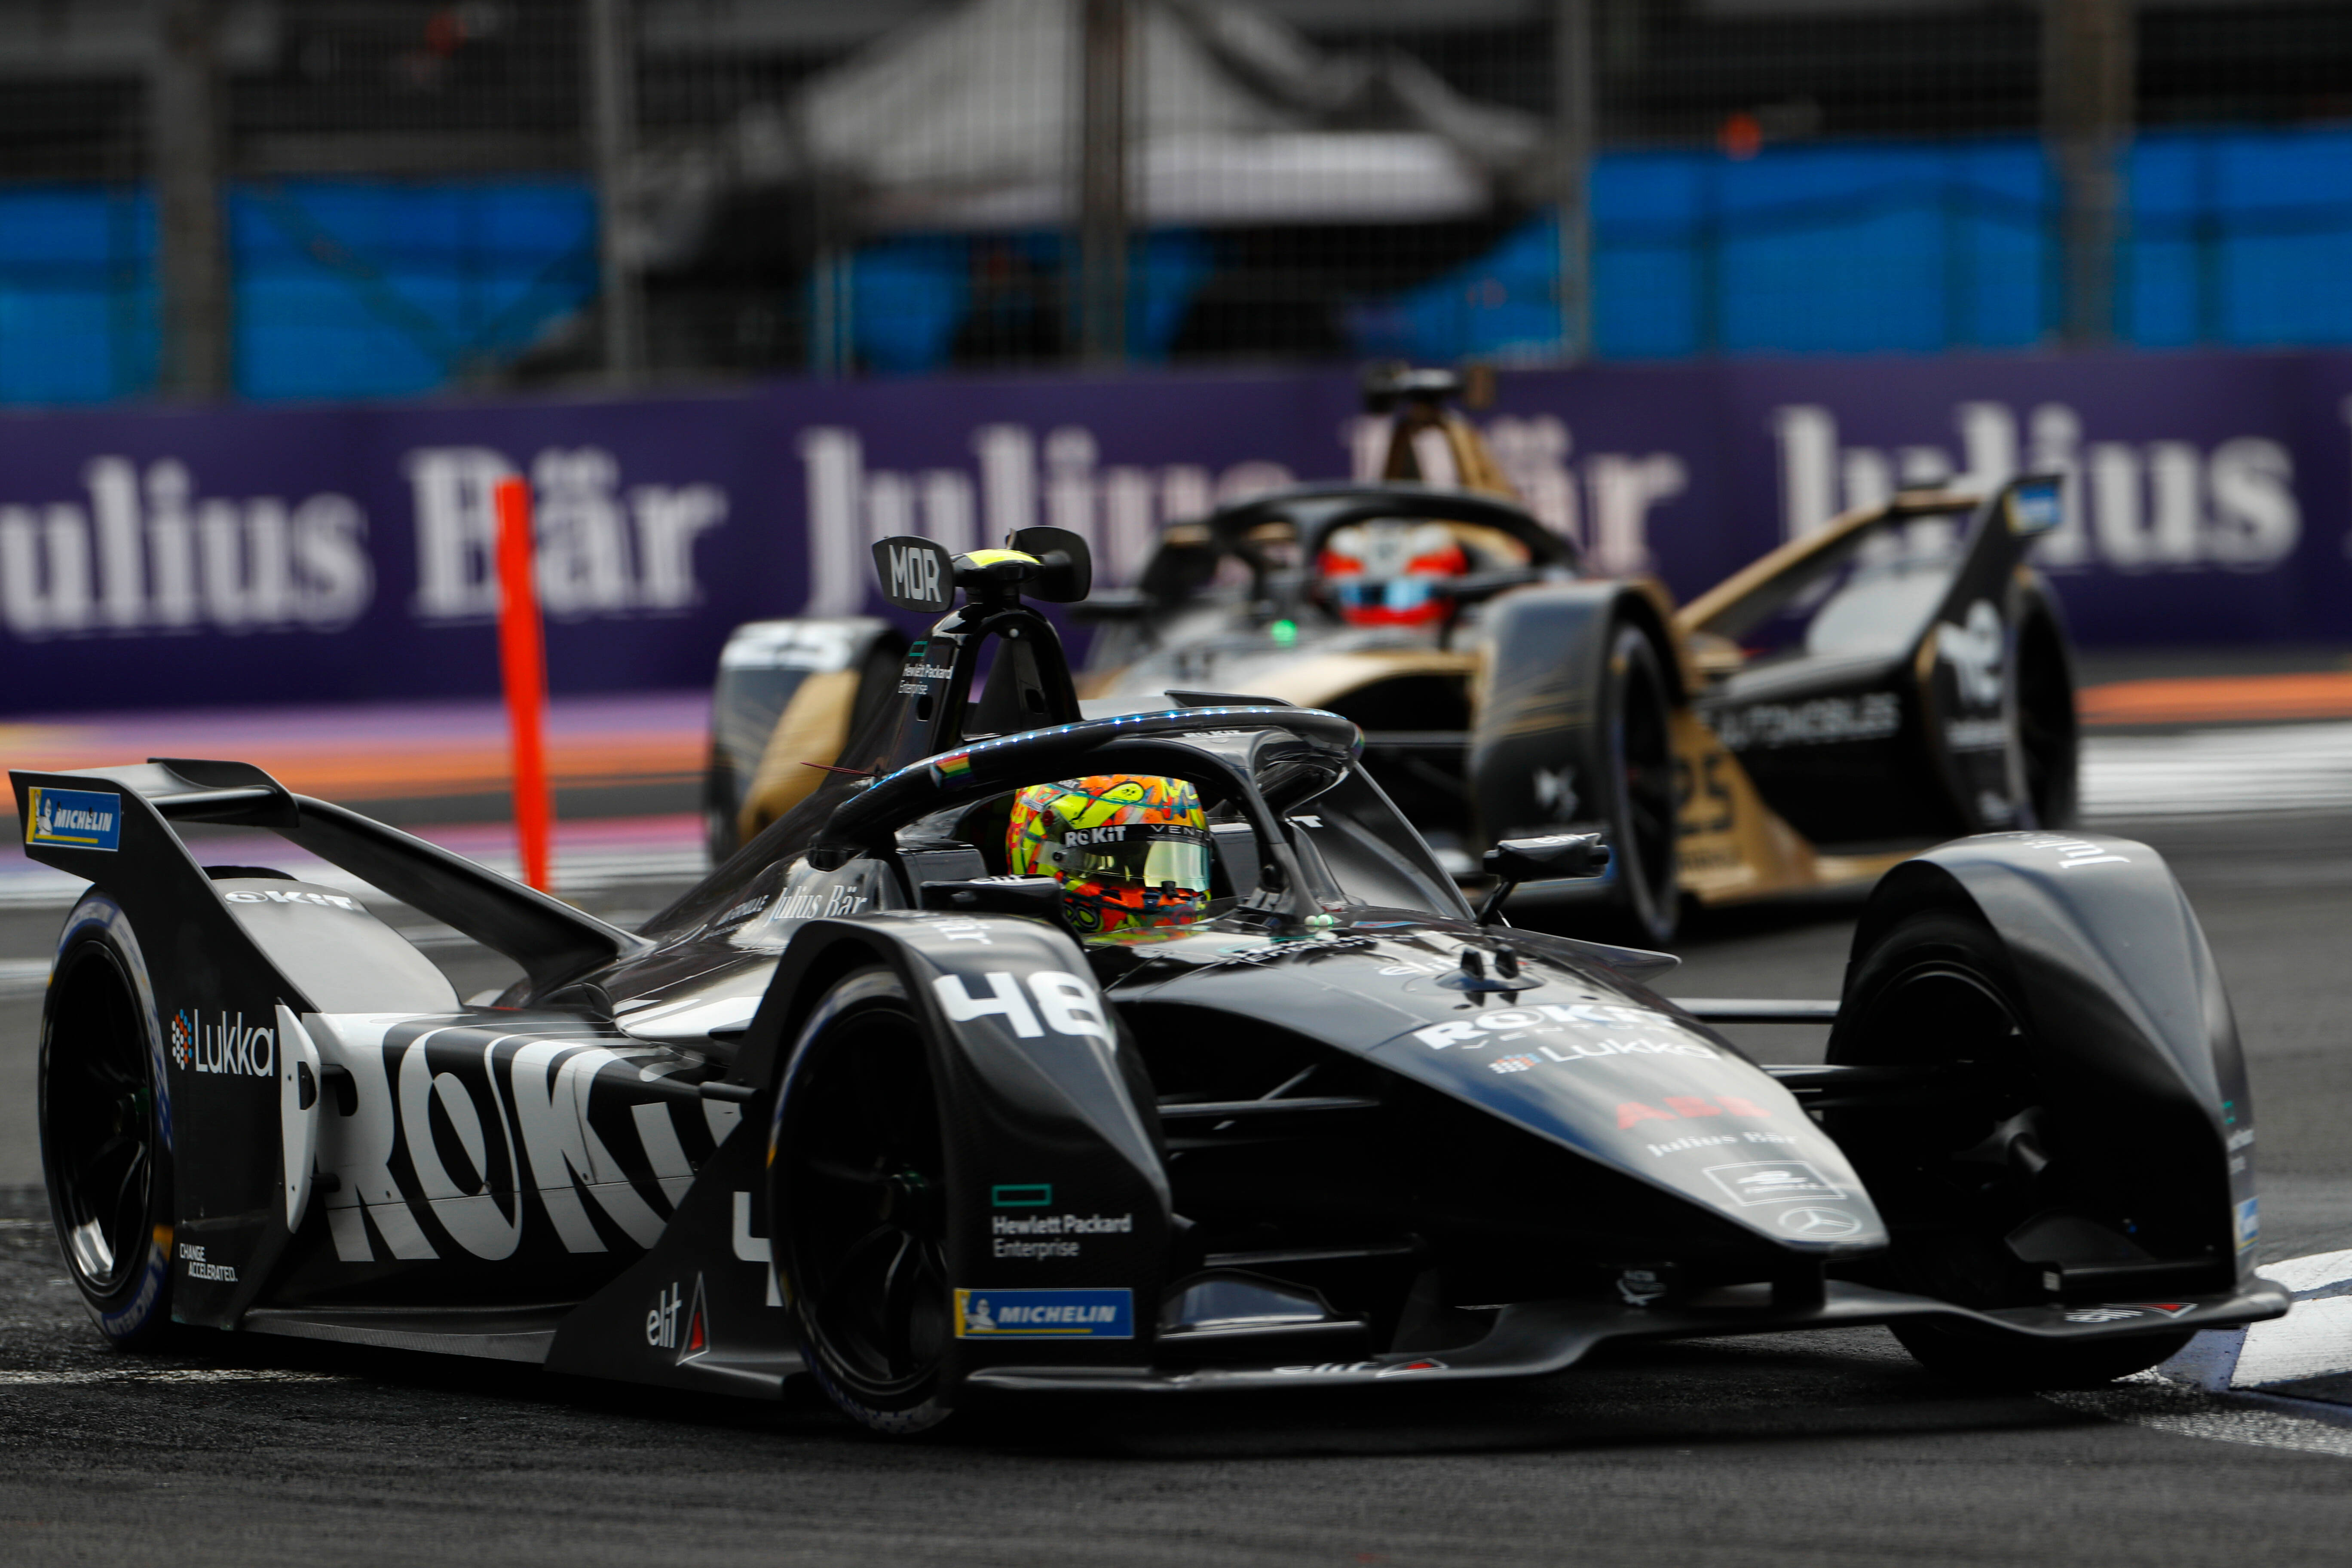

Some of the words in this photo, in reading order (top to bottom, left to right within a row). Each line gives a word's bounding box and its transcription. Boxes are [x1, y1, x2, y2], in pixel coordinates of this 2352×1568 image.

[408, 446, 726, 623] Bär
[799, 427, 1299, 618] Juliu
[888, 544, 942, 603] MOR
[903, 663, 927, 677] Hewlett
[927, 664, 954, 679] Packard
[898, 680, 928, 697] Enterprise
[54, 808, 113, 832] MICHELIN
[225, 891, 353, 910] OKiT
[763, 885, 823, 927] Julius
[823, 885, 868, 918] Bär
[933, 971, 1116, 1052] 48
[194, 1008, 274, 1077] Lukka
[1538, 1038, 1722, 1063] Lukka
[1616, 1095, 1773, 1130] ABB
[1645, 1134, 1739, 1158] Julius
[1741, 1131, 1800, 1145] Bär
[992, 1216, 1062, 1234] Hewlett
[1064, 1214, 1133, 1233] Packard
[993, 1239, 1080, 1259] Enterprise
[188, 1261, 239, 1282] ACCELERATED.
[646, 1282, 682, 1348] elit
[998, 1306, 1118, 1325] MICHELIN
